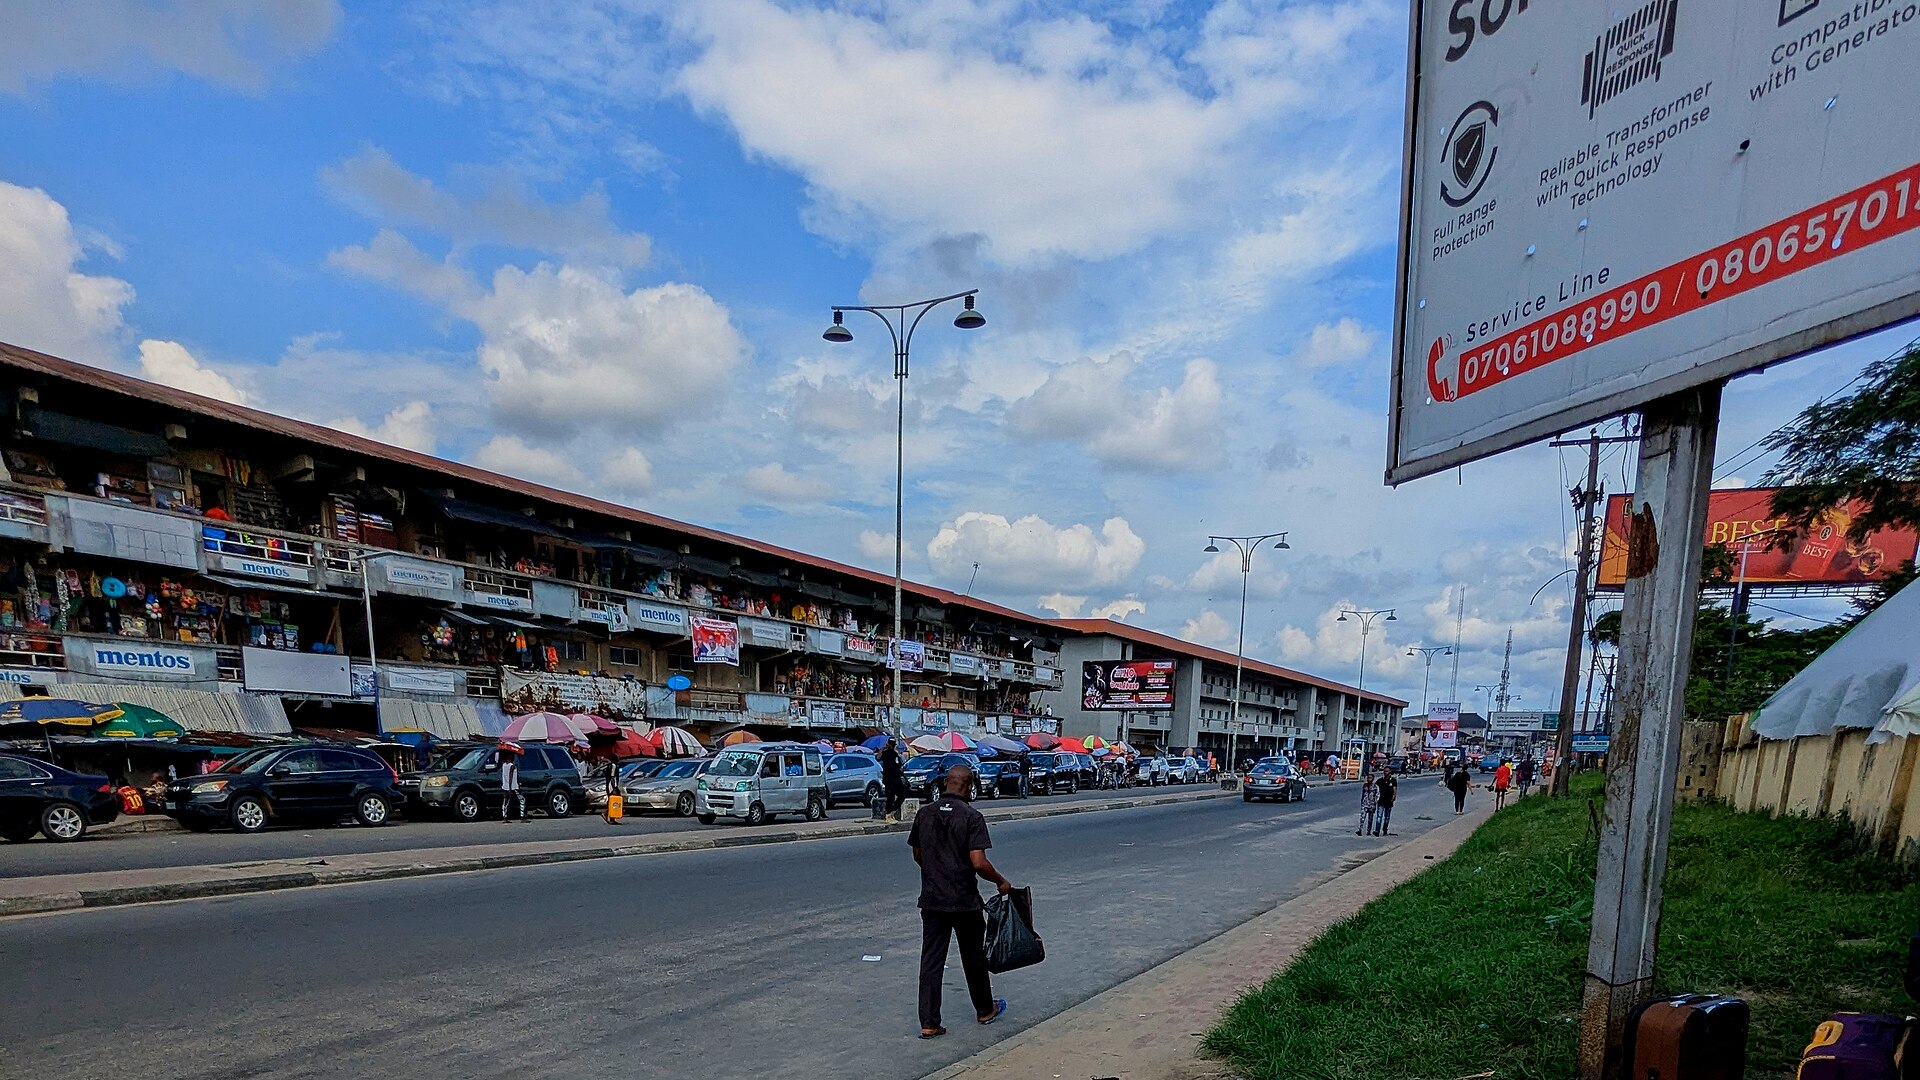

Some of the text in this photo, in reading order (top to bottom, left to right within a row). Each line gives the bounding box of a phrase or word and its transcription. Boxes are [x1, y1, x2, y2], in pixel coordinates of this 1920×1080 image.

[1606, 39, 1655, 76] RESPONSE
[1616, 31, 1646, 56] QUICK
[1750, 4, 1920, 101] with Generato
[1539, 81, 1713, 187] Reliable Transformer
[1536, 106, 1710, 208] with Quick Response
[1570, 153, 1663, 210] Technology
[1432, 219, 1495, 262] Protection
[1433, 198, 1497, 243] Full Range
[1466, 266, 1610, 343] Service Line
[1464, 281, 1661, 384] 07061088990
[242, 562, 290, 577] mentos
[1803, 544, 1831, 559] BEST
[488, 596, 519, 606] mentos
[641, 608, 681, 623] mentos
[96, 648, 190, 669] mentos
